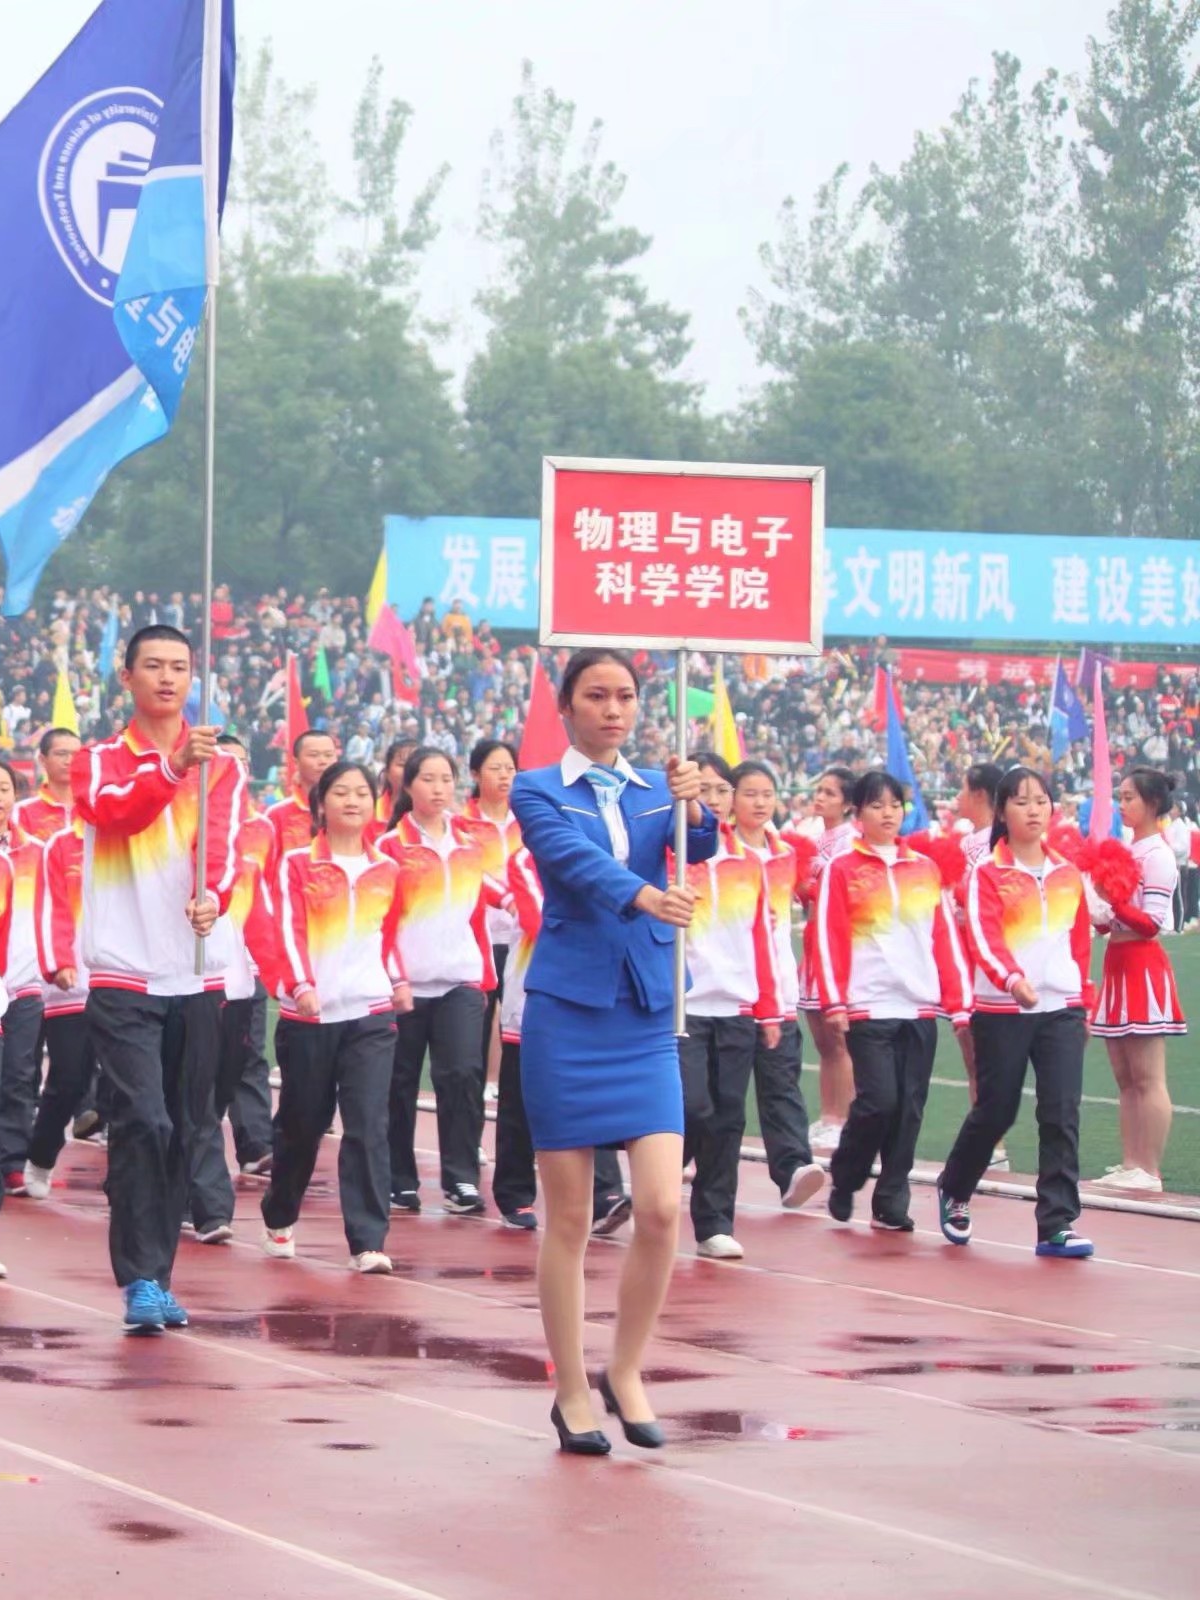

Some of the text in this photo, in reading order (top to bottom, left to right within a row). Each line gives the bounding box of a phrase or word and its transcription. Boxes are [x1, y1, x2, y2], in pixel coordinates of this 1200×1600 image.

[573, 507, 793, 559] 物理与电子
[439, 533, 540, 611] 发展
[595, 561, 770, 610] 科学学院
